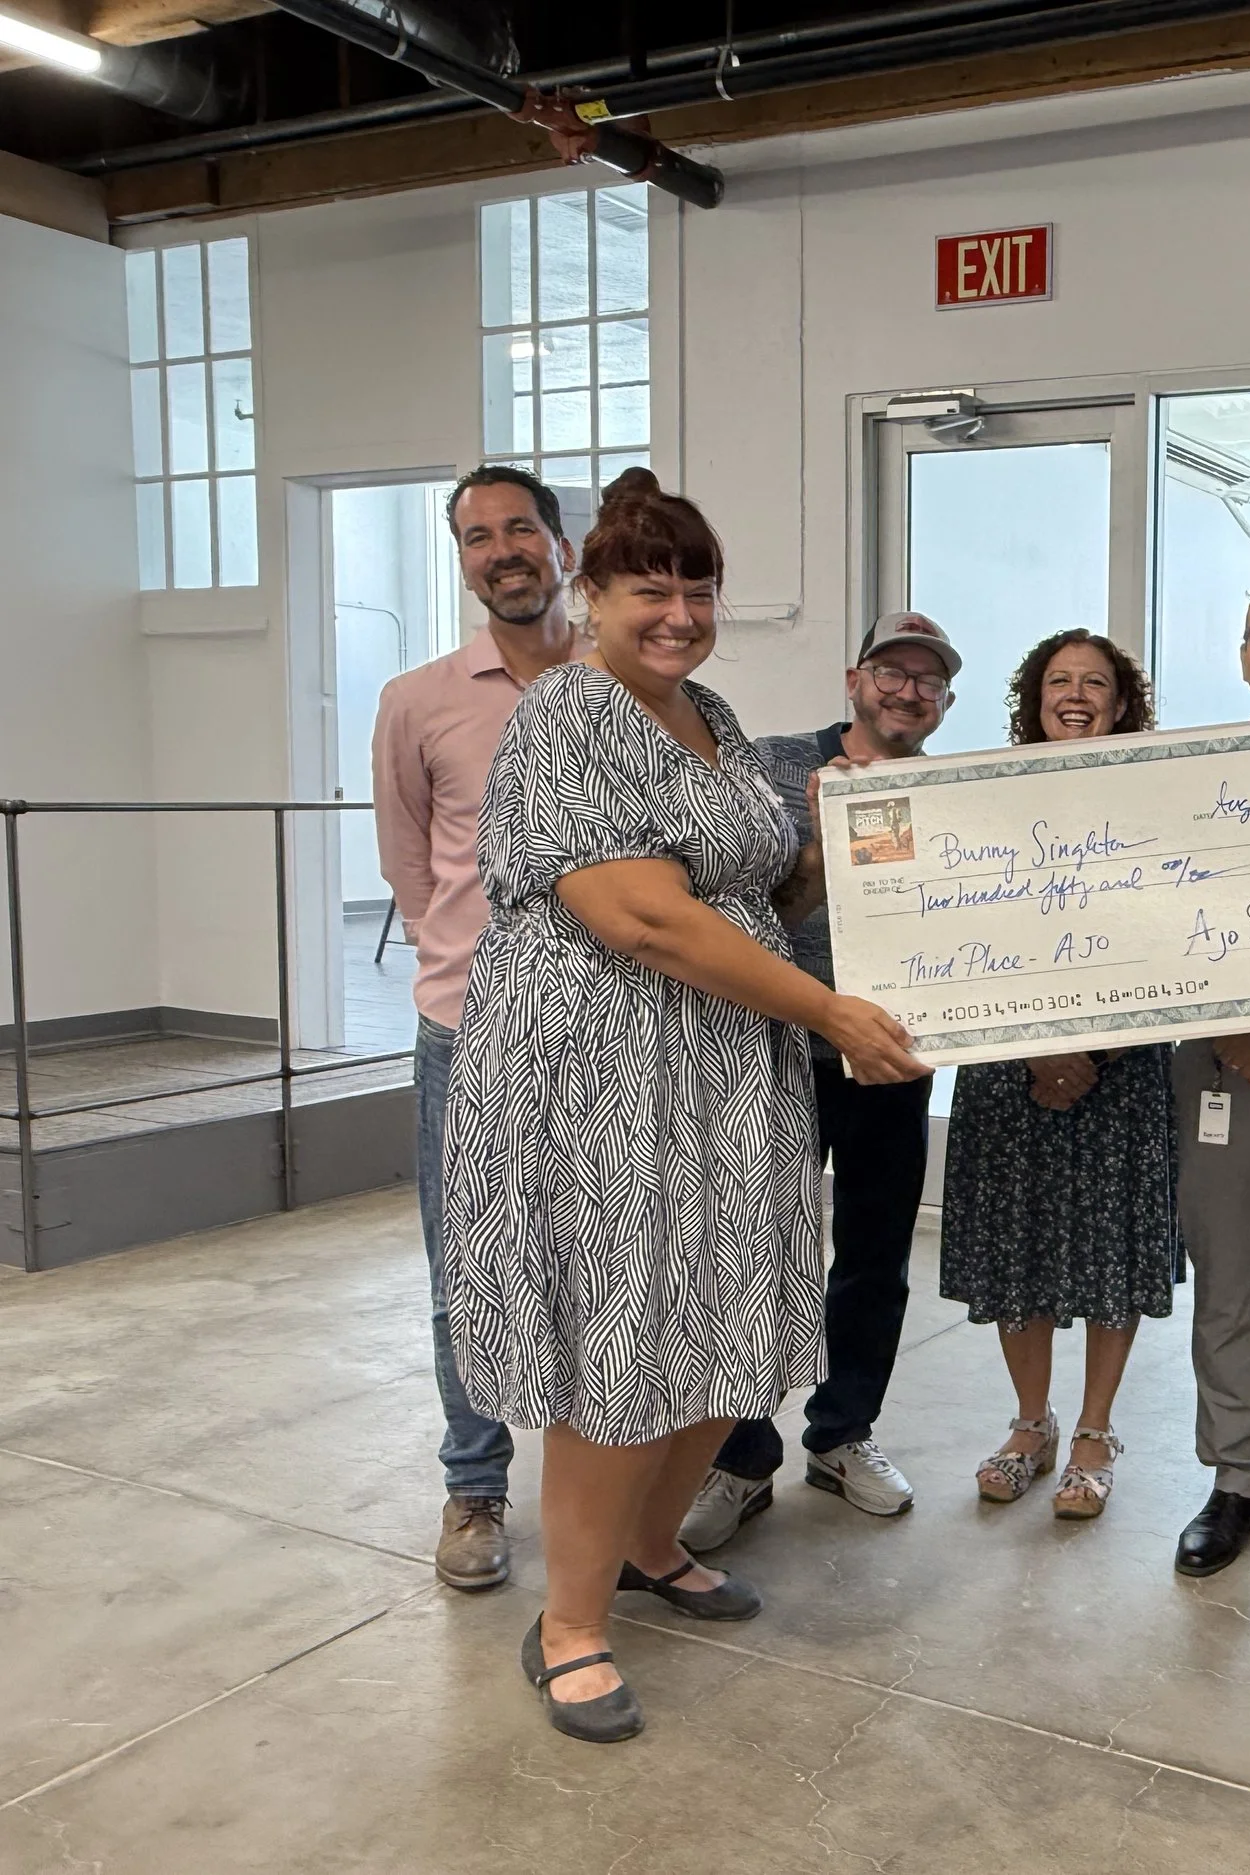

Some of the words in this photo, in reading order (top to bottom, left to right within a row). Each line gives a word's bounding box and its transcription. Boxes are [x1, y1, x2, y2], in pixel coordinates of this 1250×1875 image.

[958, 235, 1033, 298] EXIT
[856, 815, 884, 827] PITCH
[929, 832, 1019, 884] Bunny
[1184, 908, 1239, 961] Ajo
[900, 951, 955, 988] Third
